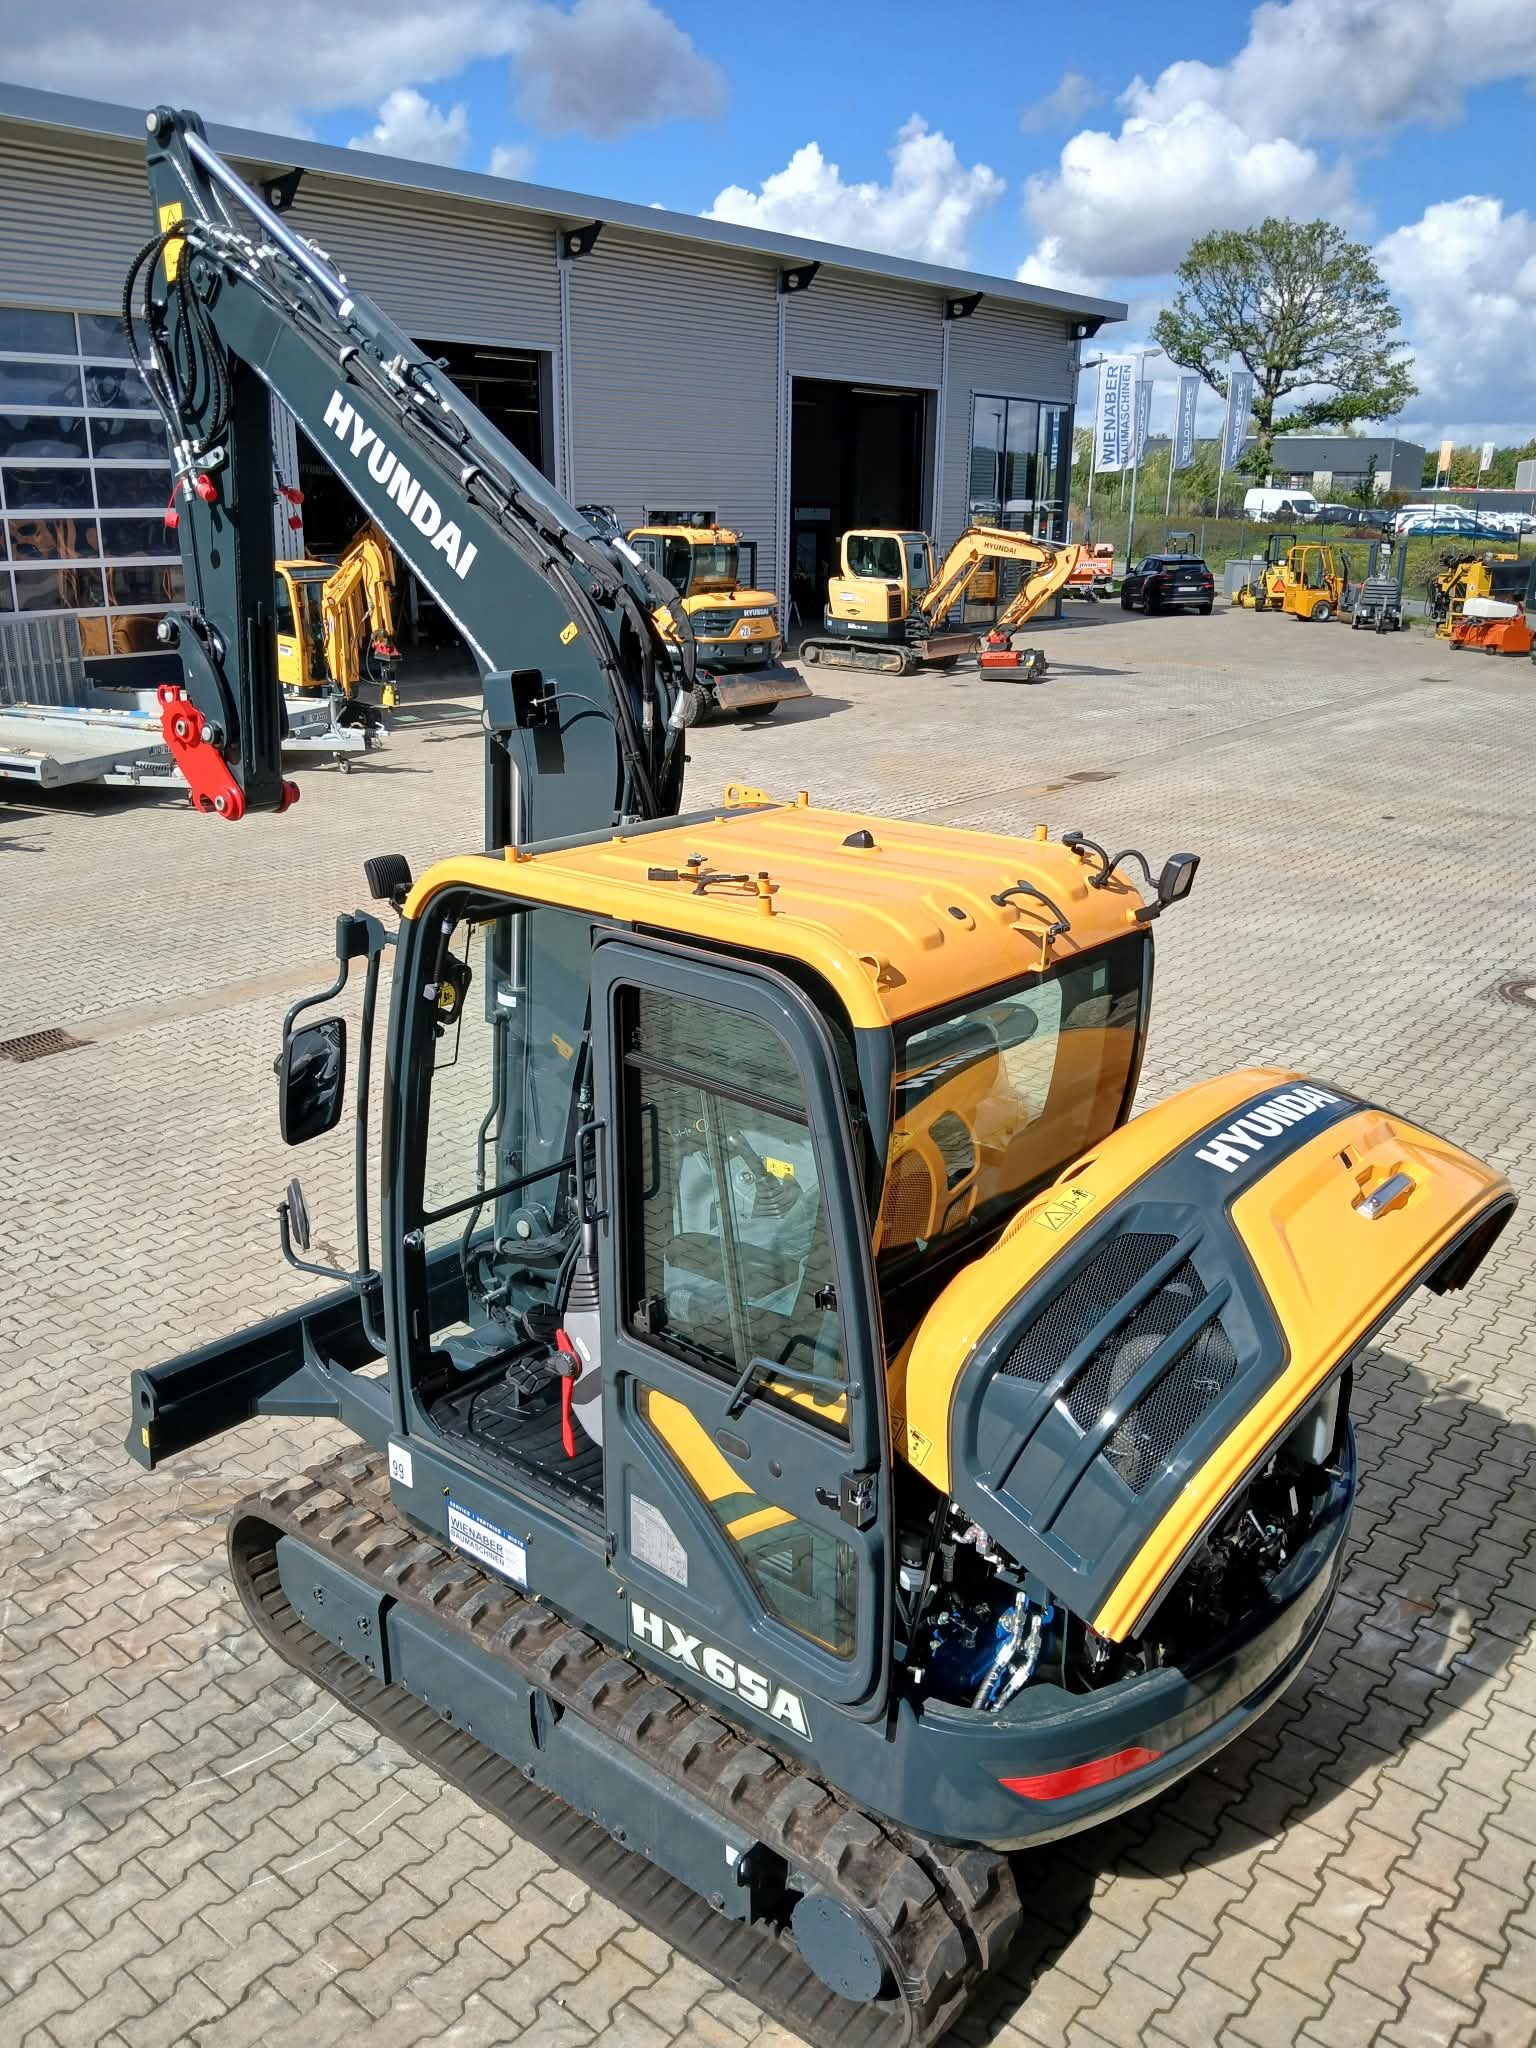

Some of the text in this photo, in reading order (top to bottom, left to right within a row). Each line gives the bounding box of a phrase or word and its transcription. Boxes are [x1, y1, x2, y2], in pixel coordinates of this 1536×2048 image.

[1120, 364, 1132, 464] BAUMASCHINEN
[323, 389, 478, 580] HYUNDAI
[984, 542, 1017, 555] HYUNDAI
[744, 608, 769, 617] HYUNDAI
[1194, 1085, 1343, 1174] HYUNDAI
[393, 1459, 405, 1480] 99
[631, 1601, 808, 1736] HX65A
